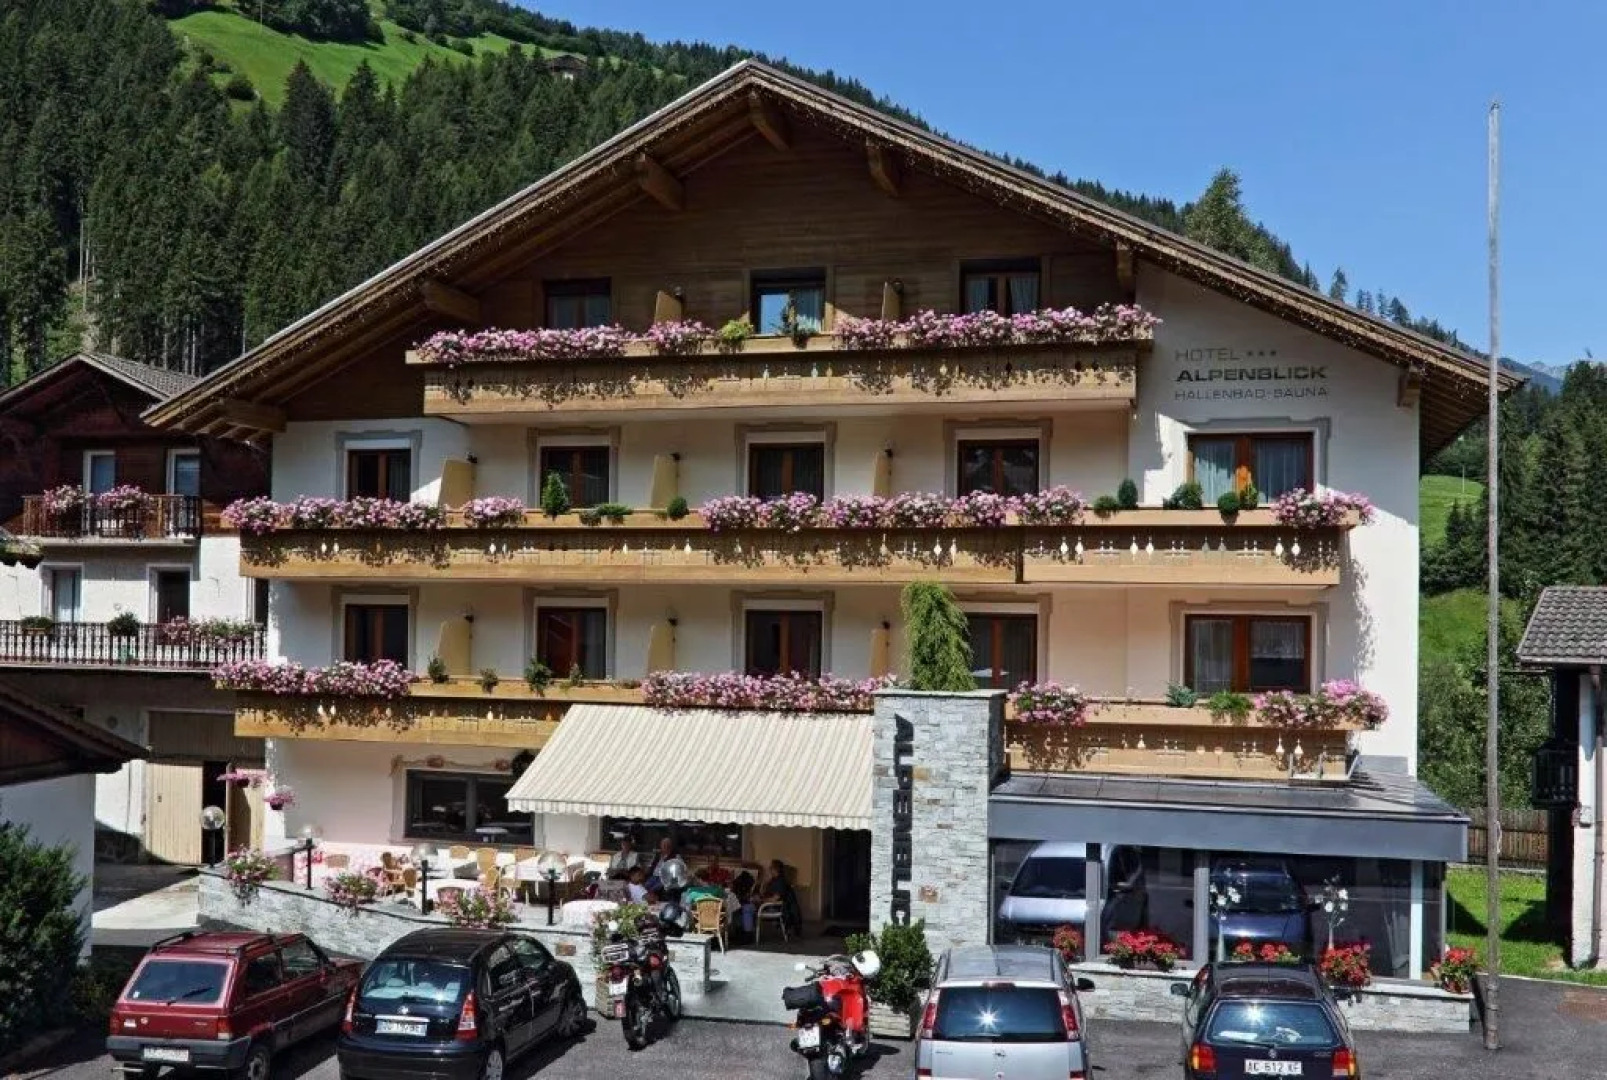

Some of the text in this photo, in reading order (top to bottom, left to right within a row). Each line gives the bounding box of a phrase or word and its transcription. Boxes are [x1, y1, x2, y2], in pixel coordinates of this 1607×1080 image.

[1175, 348, 1240, 361] HOTEL
[1175, 366, 1328, 382] ALPENBLICK
[891, 713, 914, 926] ALPENBLIC
